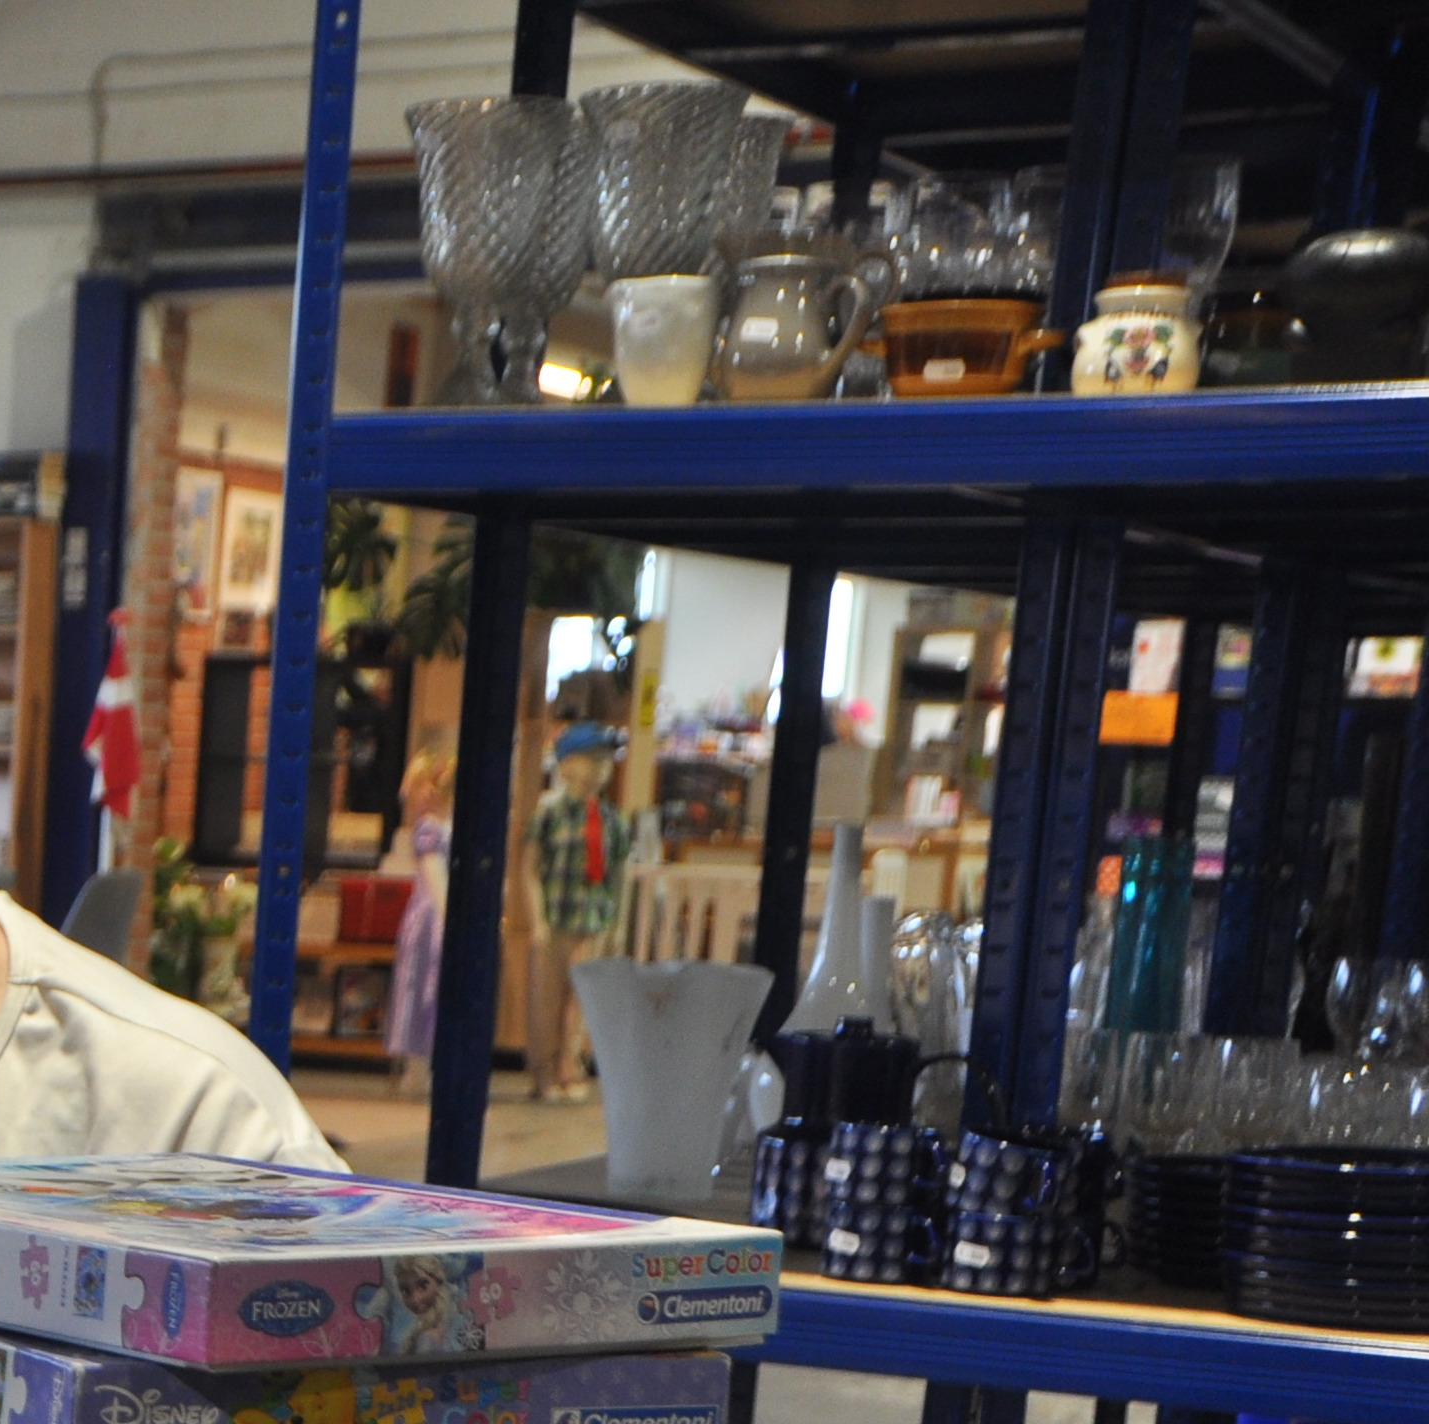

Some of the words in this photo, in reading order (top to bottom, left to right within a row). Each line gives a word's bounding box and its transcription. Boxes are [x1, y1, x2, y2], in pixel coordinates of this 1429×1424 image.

[631, 1250, 705, 1284] Super
[706, 1246, 774, 1277] Color
[251, 1298, 322, 1323] FROZEN
[663, 1289, 765, 1319] Clementoni
[442, 1376, 532, 1408] Super
